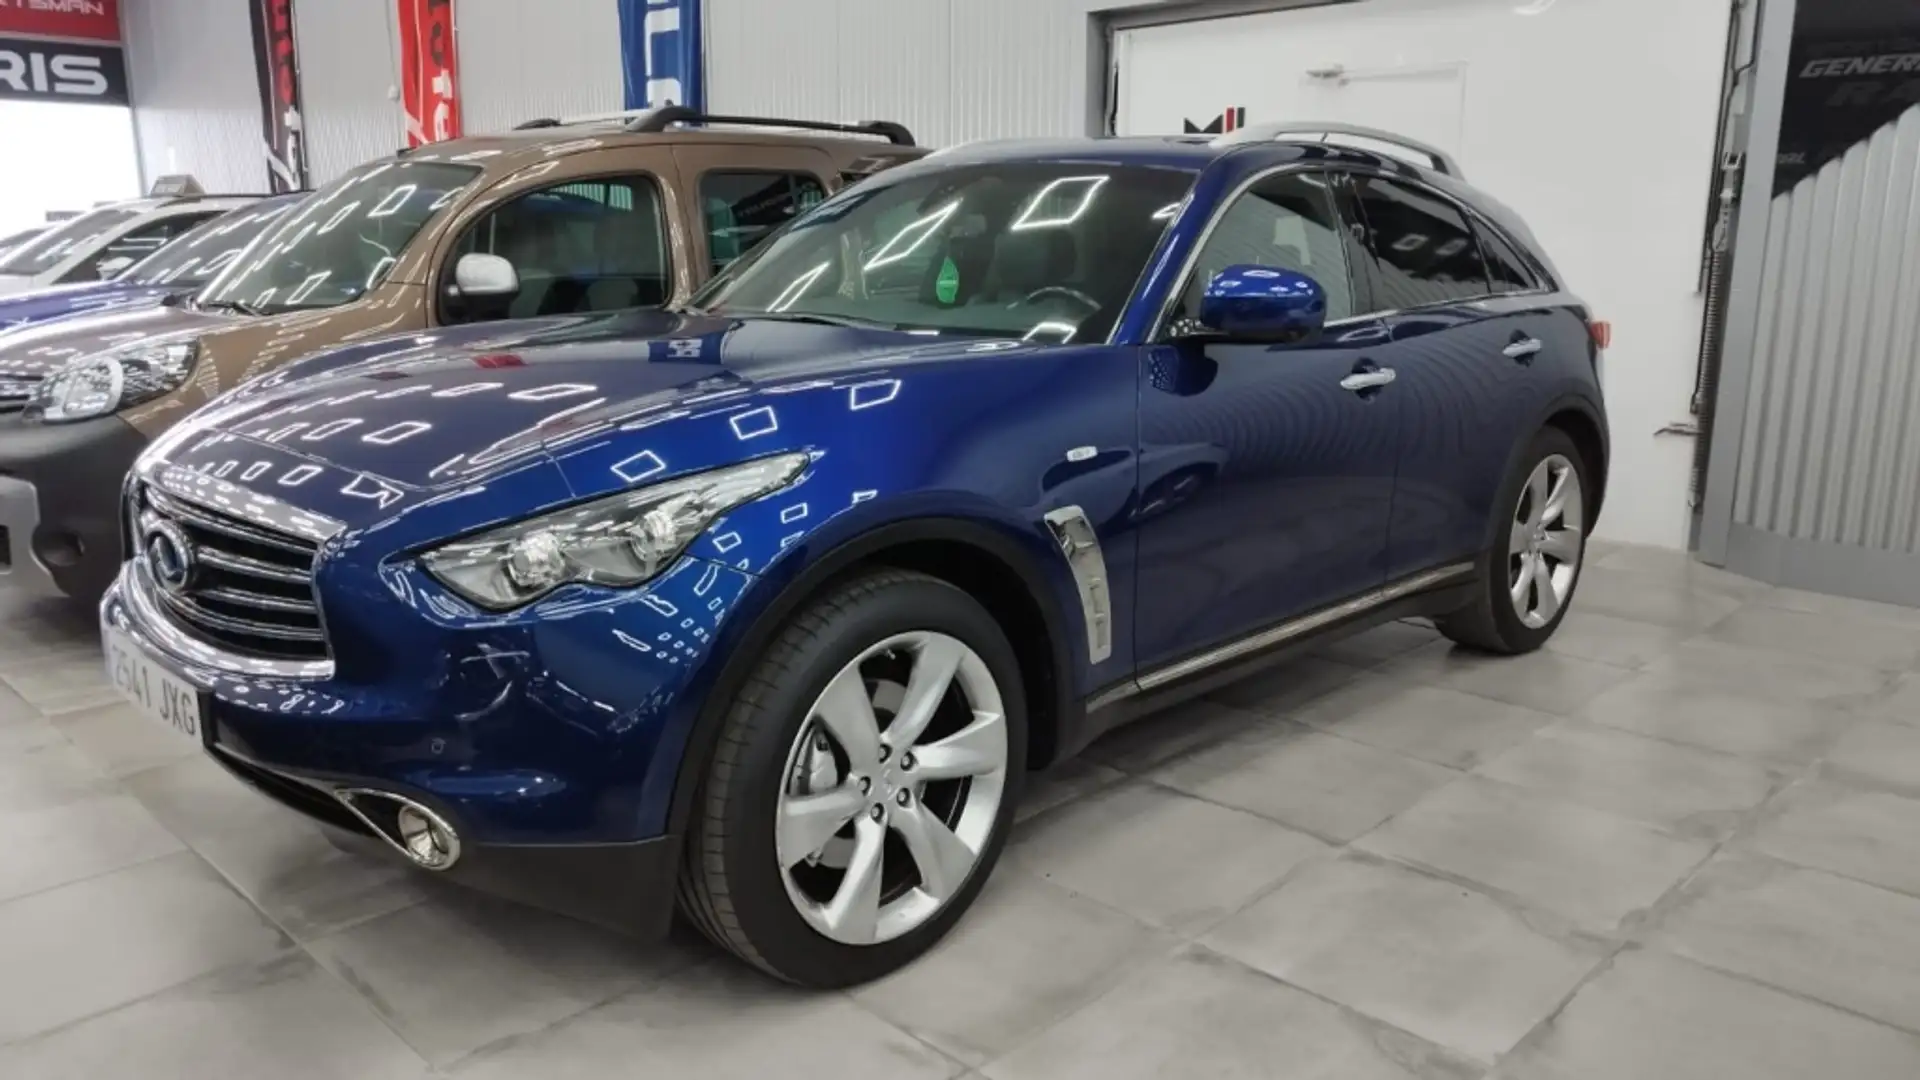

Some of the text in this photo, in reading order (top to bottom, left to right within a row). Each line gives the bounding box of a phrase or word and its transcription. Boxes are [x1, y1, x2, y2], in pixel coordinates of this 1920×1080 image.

[0, 50, 108, 95] RIS
[1799, 53, 1920, 78] GENER
[159, 678, 196, 736] JXG
